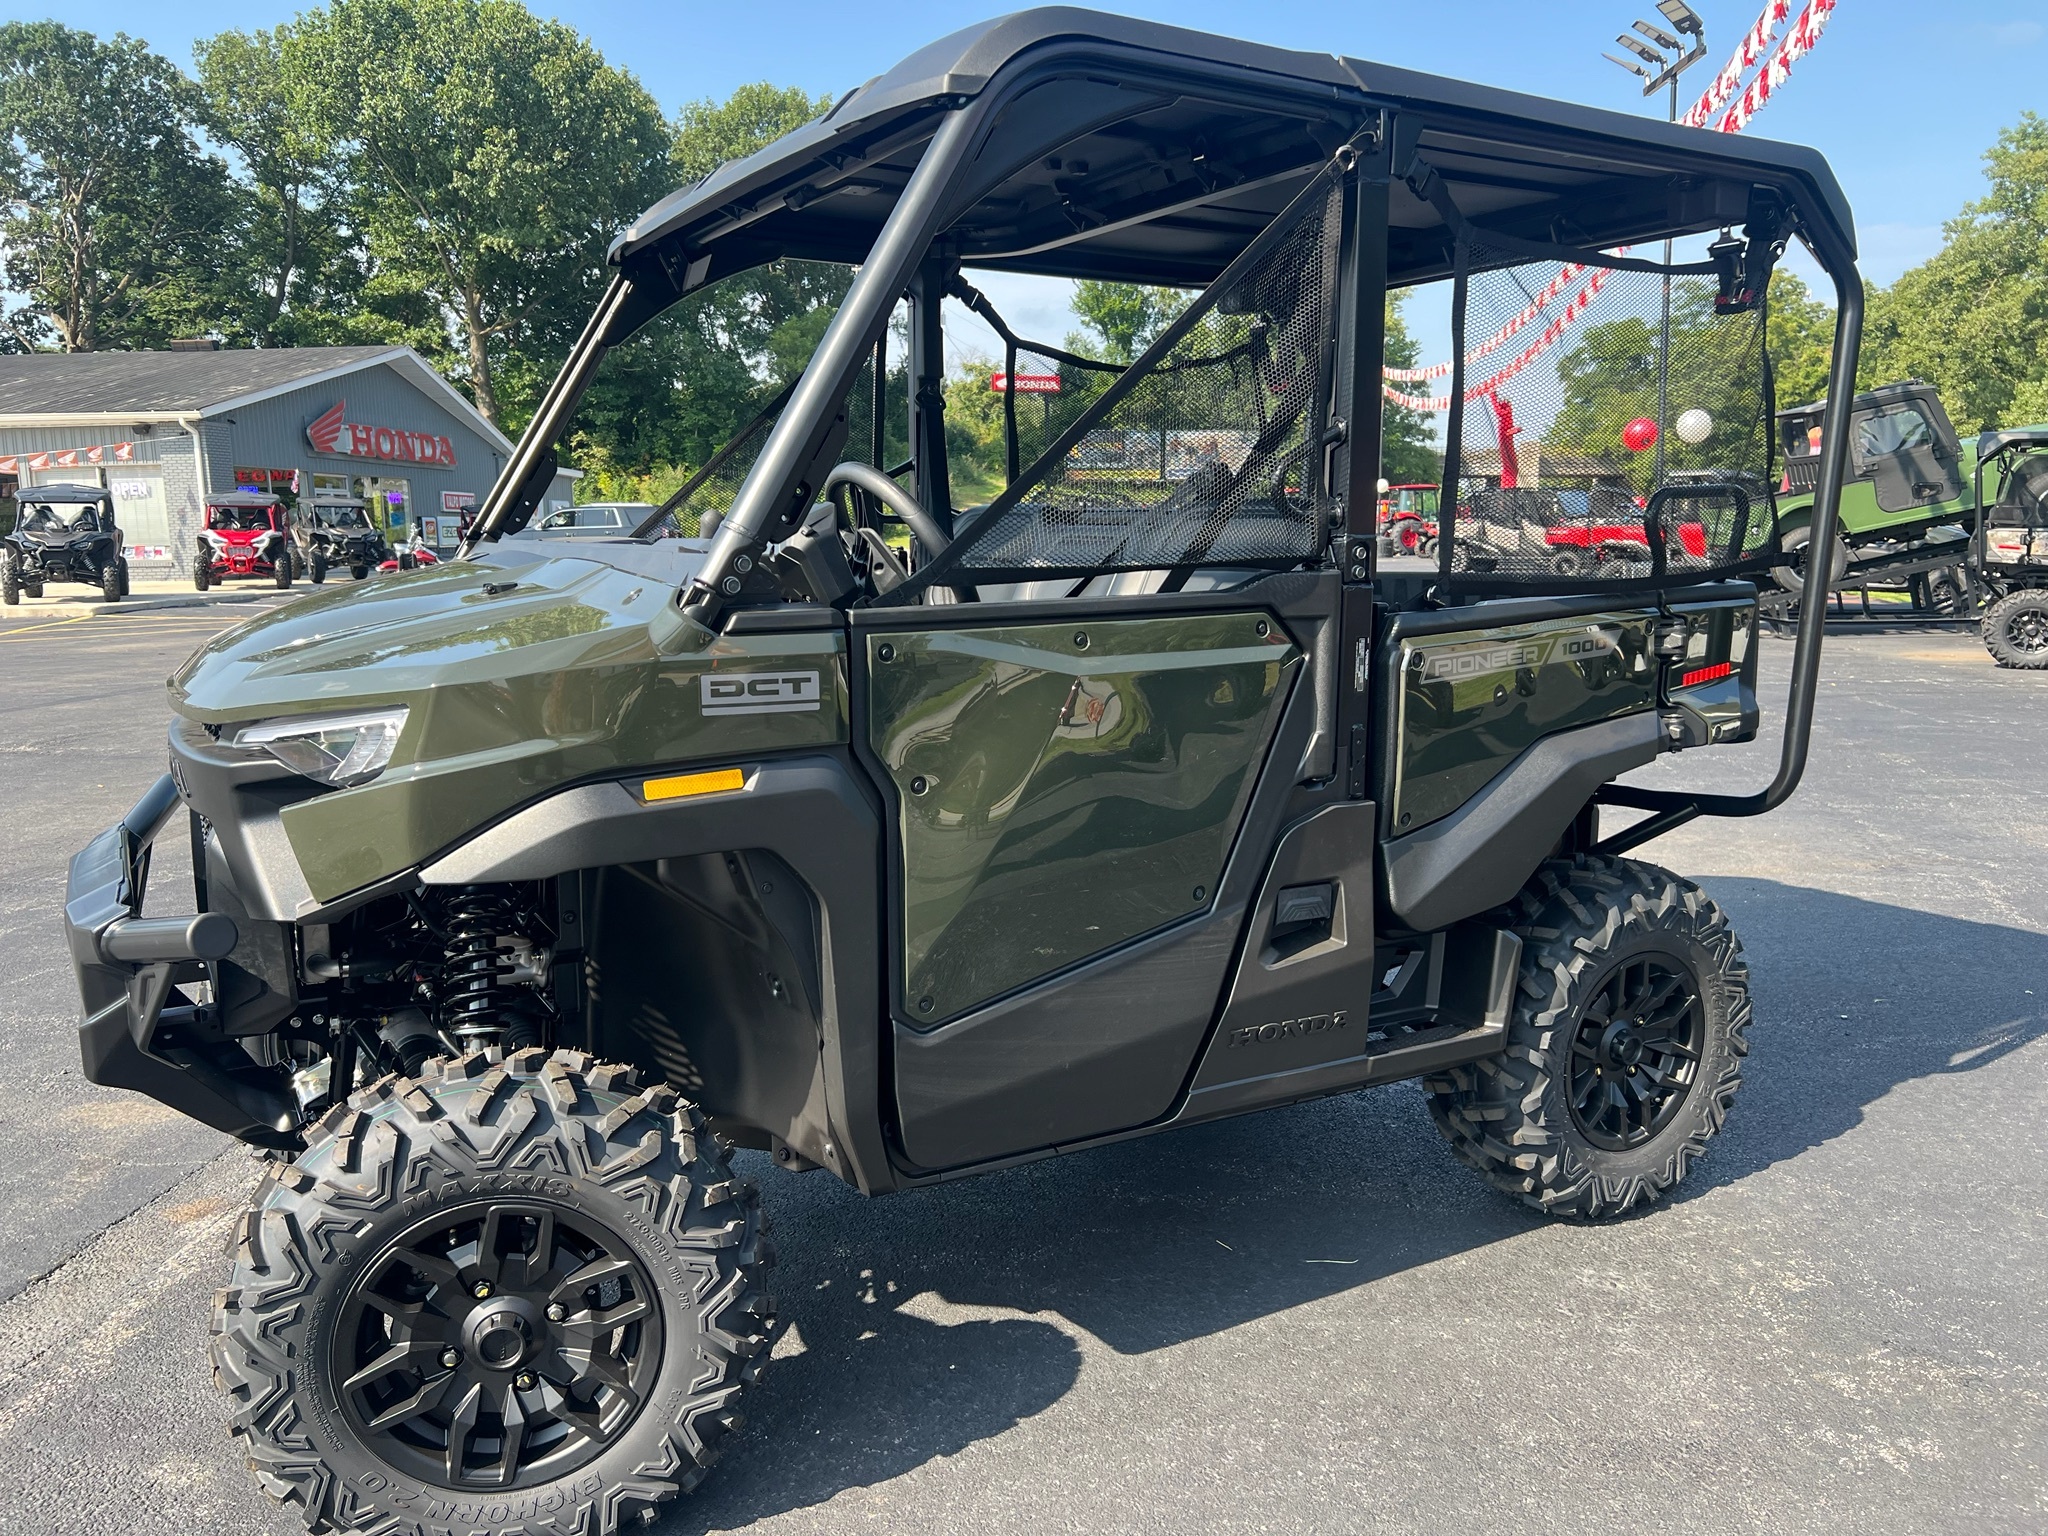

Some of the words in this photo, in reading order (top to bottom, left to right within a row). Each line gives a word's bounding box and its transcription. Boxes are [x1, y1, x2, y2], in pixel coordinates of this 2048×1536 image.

[348, 422, 457, 465] HONDA
[111, 481, 148, 496] OPEN
[442, 527, 458, 537] EZG
[1434, 647, 1539, 677] PIONEER
[1562, 637, 1608, 656] 1000
[709, 676, 812, 698] DCT
[1227, 1010, 1348, 1048] HONDA
[402, 1174, 574, 1217] MAXXIS
[358, 1470, 420, 1509] 2.0
[422, 1470, 603, 1525] BIGHORN
